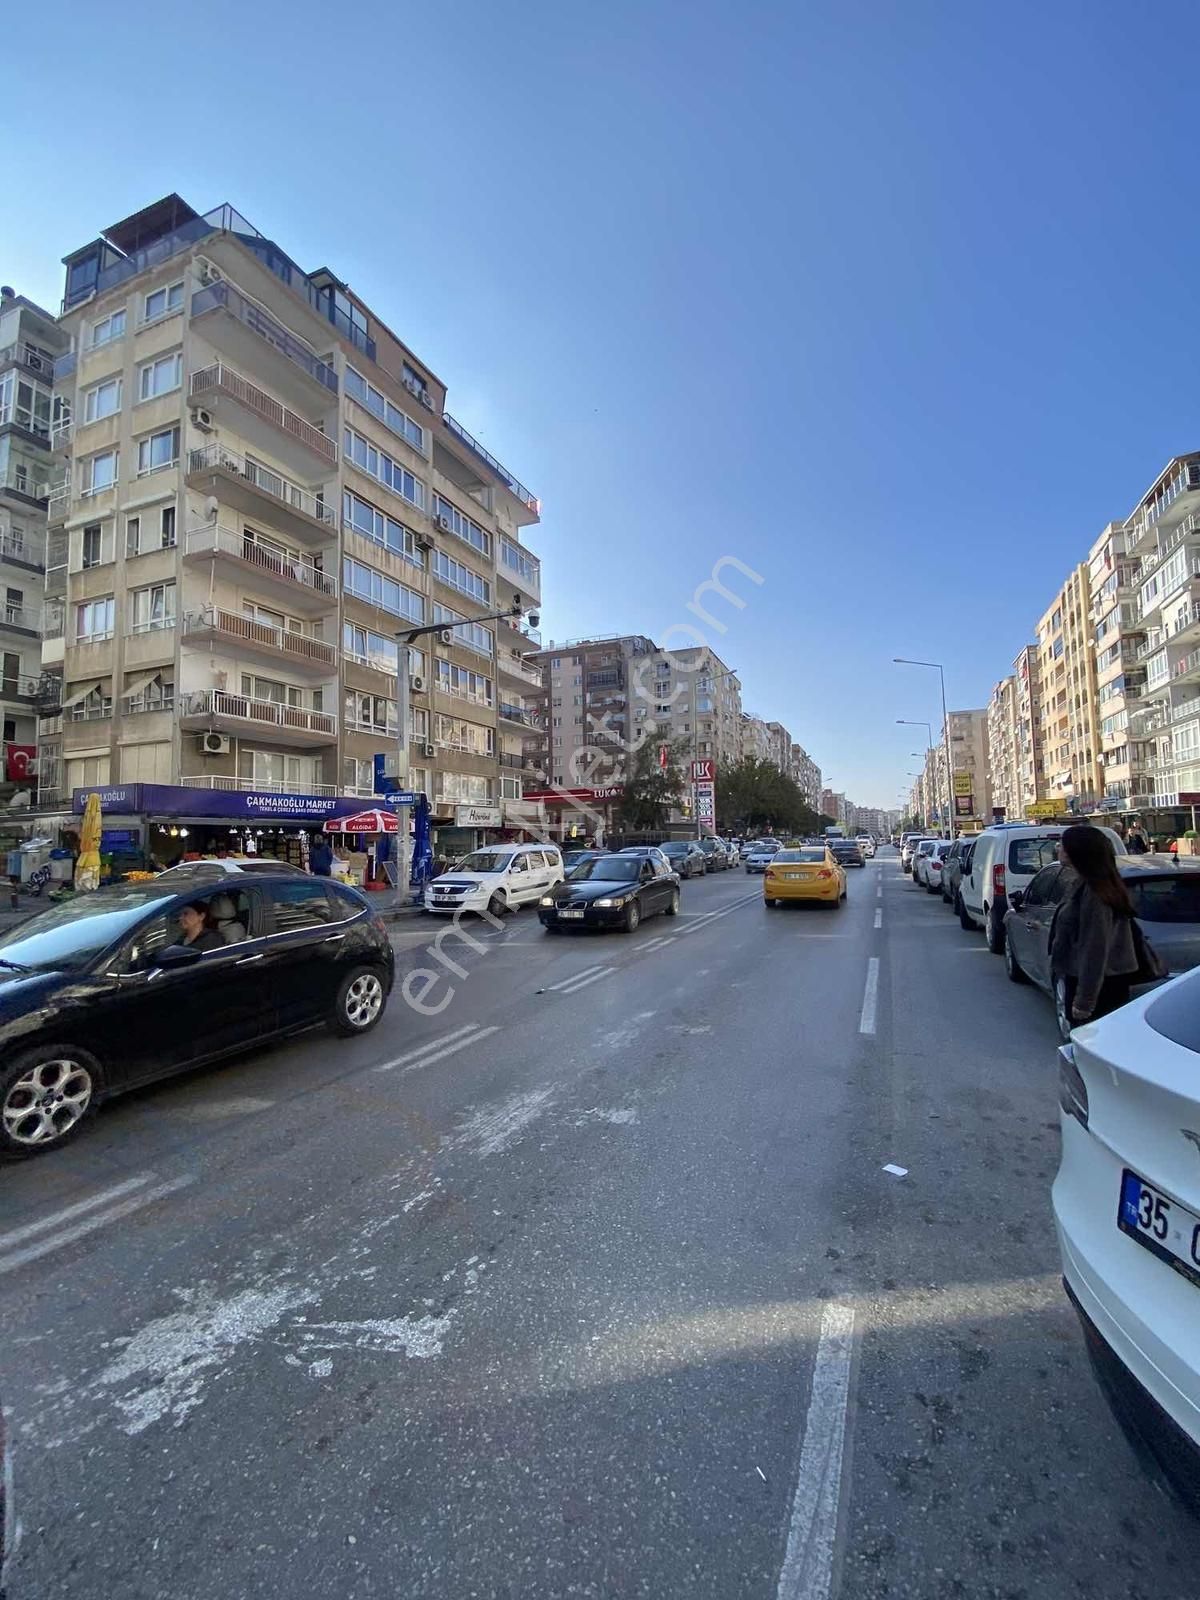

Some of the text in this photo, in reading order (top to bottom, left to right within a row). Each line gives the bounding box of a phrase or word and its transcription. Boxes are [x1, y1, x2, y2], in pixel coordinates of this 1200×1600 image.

[594, 788, 624, 799] LUKOL
[246, 796, 336, 809] ÇAKMAKOĞLU MARKET
[1137, 1190, 1170, 1240] 35
